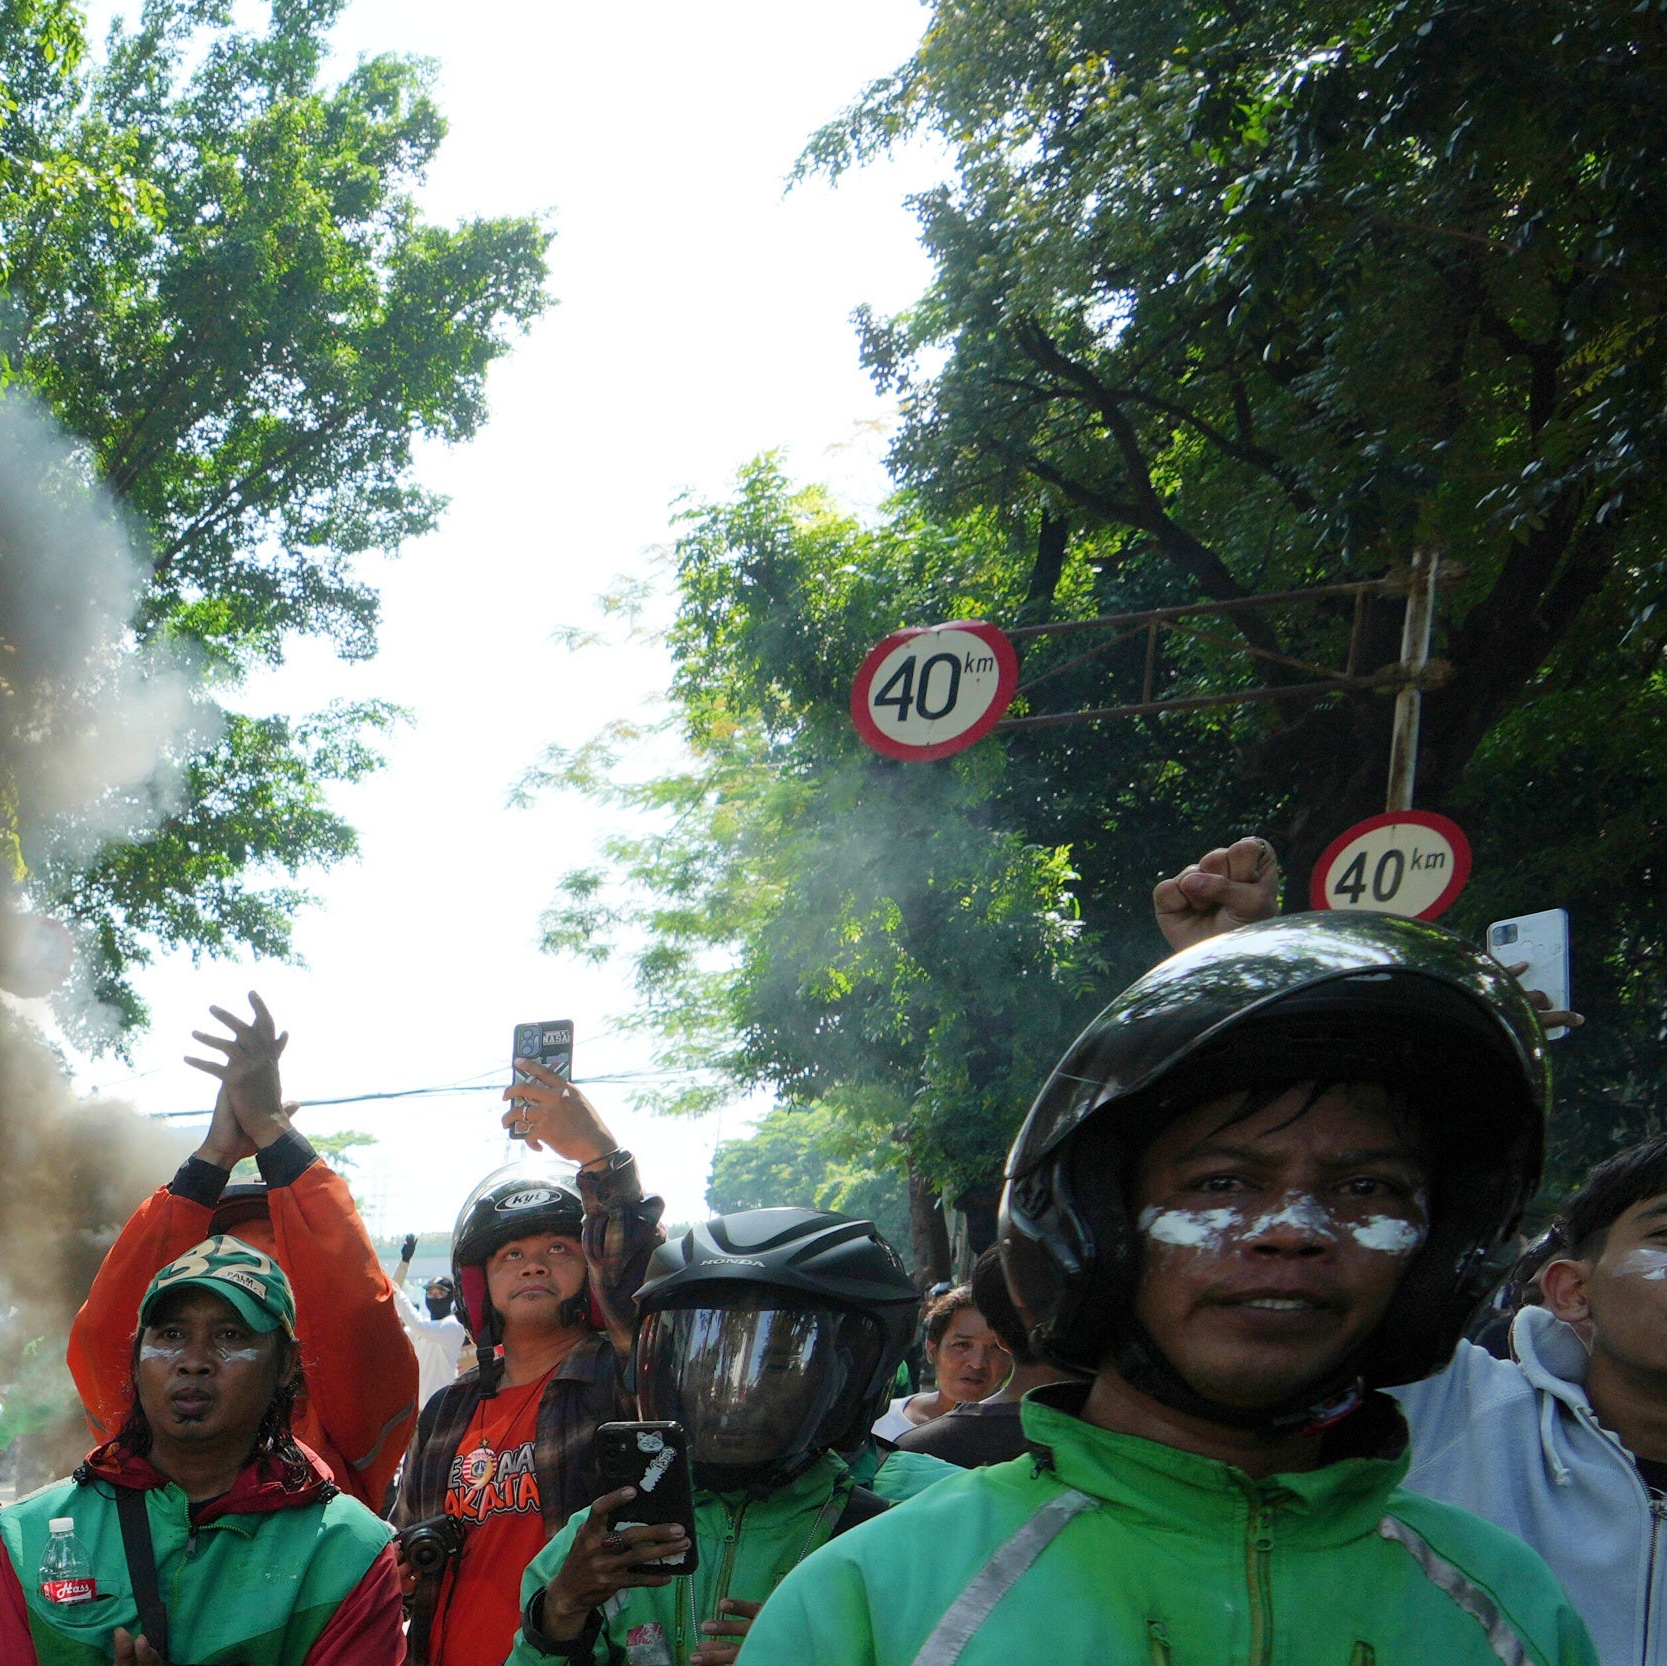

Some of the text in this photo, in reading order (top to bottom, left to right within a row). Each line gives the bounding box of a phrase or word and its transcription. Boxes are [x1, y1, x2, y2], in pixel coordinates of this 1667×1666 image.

[873, 651, 994, 722] 40 km
[1334, 848, 1445, 904] 40 km
[700, 1257, 767, 1268] HONDA
[56, 1582, 90, 1599] Hass
